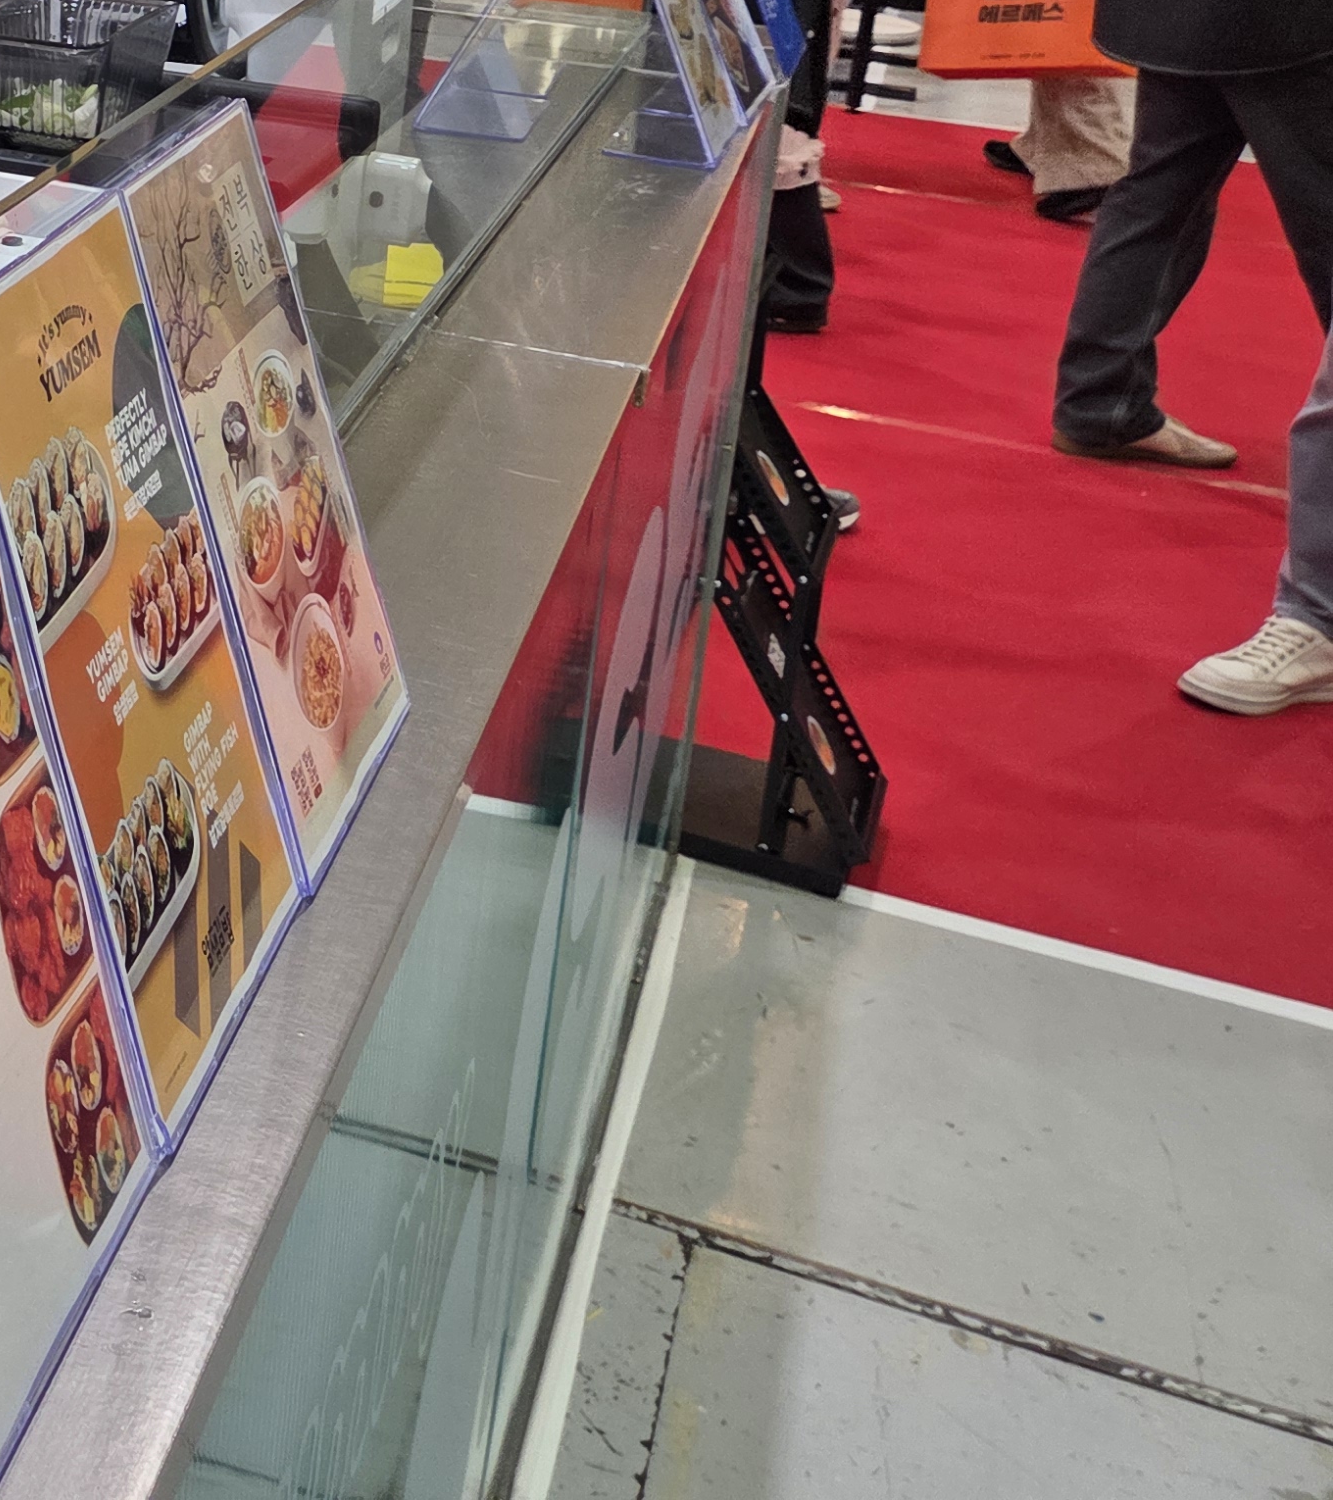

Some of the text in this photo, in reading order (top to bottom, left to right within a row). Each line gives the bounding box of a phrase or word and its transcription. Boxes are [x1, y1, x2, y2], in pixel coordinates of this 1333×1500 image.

[40, 329, 102, 402] YUMSEM
[105, 388, 147, 445] PERFECTLY
[111, 436, 130, 468] RIPE
[127, 408, 157, 451] KIMCHI
[116, 462, 140, 491] TUNA
[139, 424, 167, 468] GIMBAP
[86, 626, 124, 684] YUMSEM
[97, 649, 129, 702] GIMBAP
[184, 701, 213, 753] GIMBAP
[188, 734, 210, 774] WITH
[194, 753, 221, 799] FLYING
[220, 721, 239, 758] FISH
[201, 783, 219, 815] ROE
